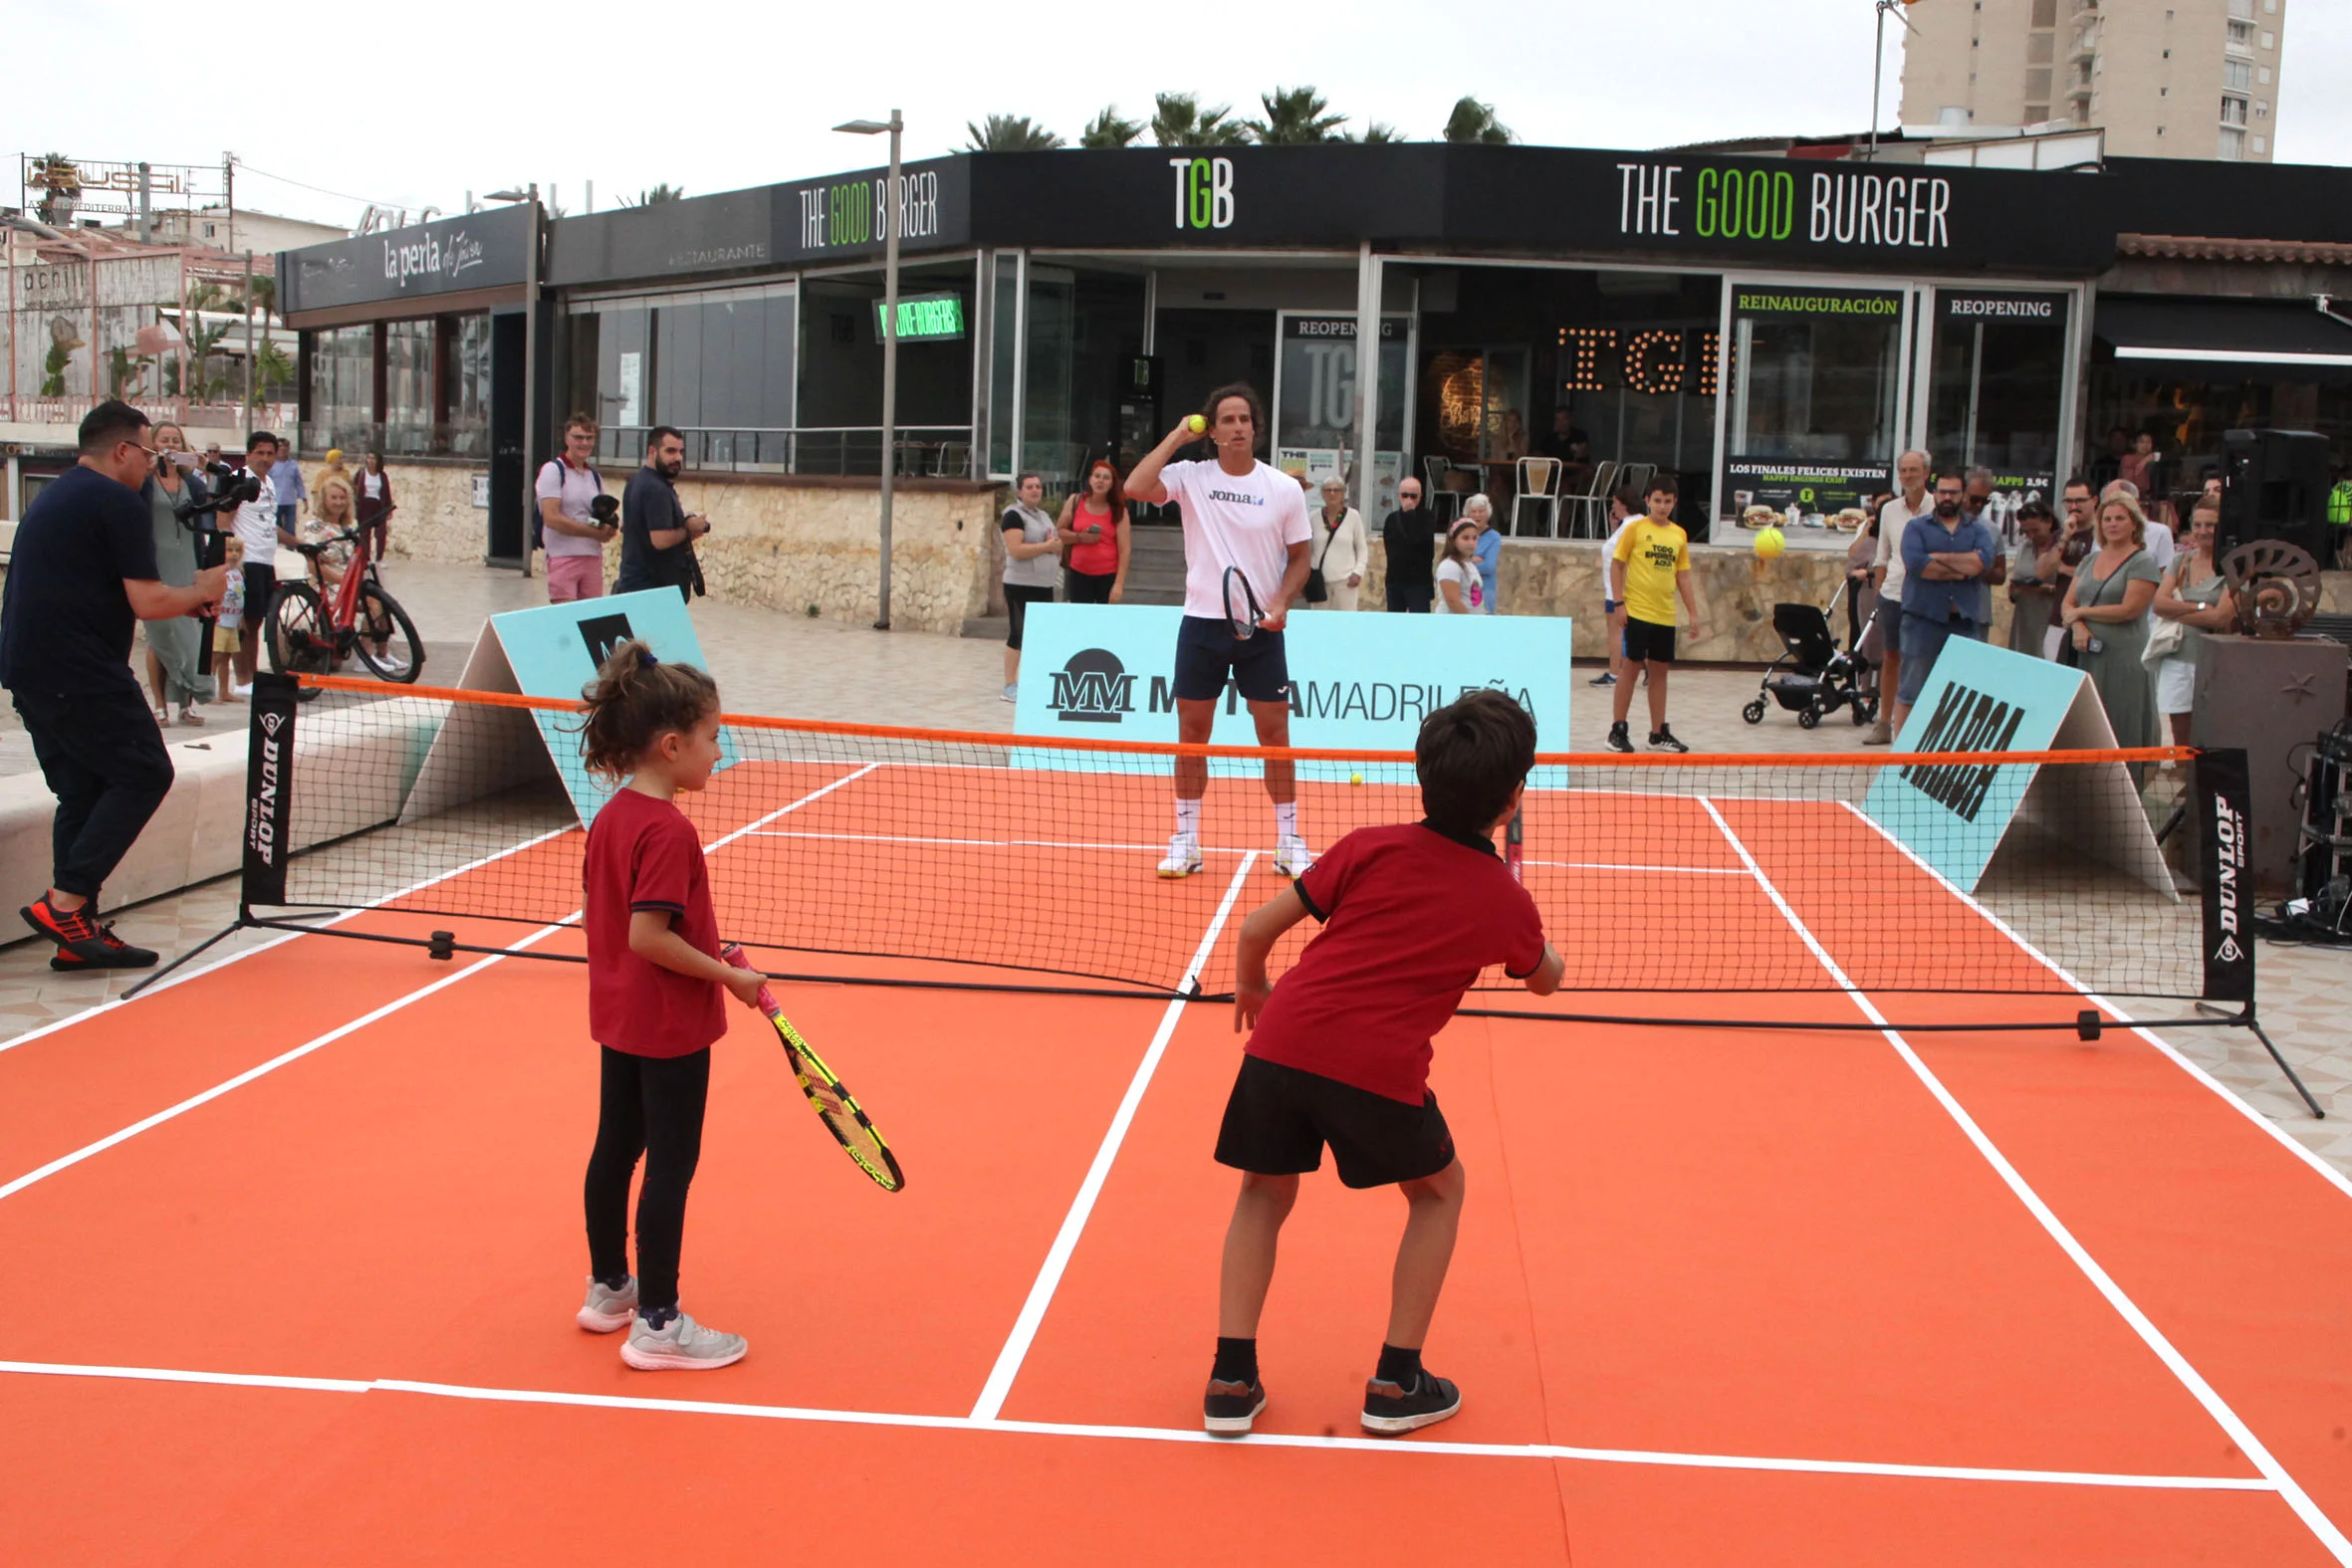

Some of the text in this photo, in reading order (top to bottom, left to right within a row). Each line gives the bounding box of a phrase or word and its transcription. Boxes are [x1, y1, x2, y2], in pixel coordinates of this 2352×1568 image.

[799, 170, 937, 249] THE GOOD BRGER
[1168, 157, 1235, 229] TGB
[1616, 163, 1951, 248] THE GOOD BURGER
[383, 239, 398, 279] la
[399, 232, 441, 288] perla
[1298, 321, 1392, 336] REOPENG
[1739, 295, 1898, 315] REINAUGURACIÓN
[1951, 300, 2051, 317] REOPENING
[1730, 464, 1887, 479] LOS FINALES FELICES EXISTEN
[1899, 680, 2025, 823] MARCA
[250, 797, 259, 850] SPORT
[256, 737, 280, 866] DUNLOP
[2216, 794, 2238, 935] DUNLOP
[2235, 811, 2245, 868] SPORT
